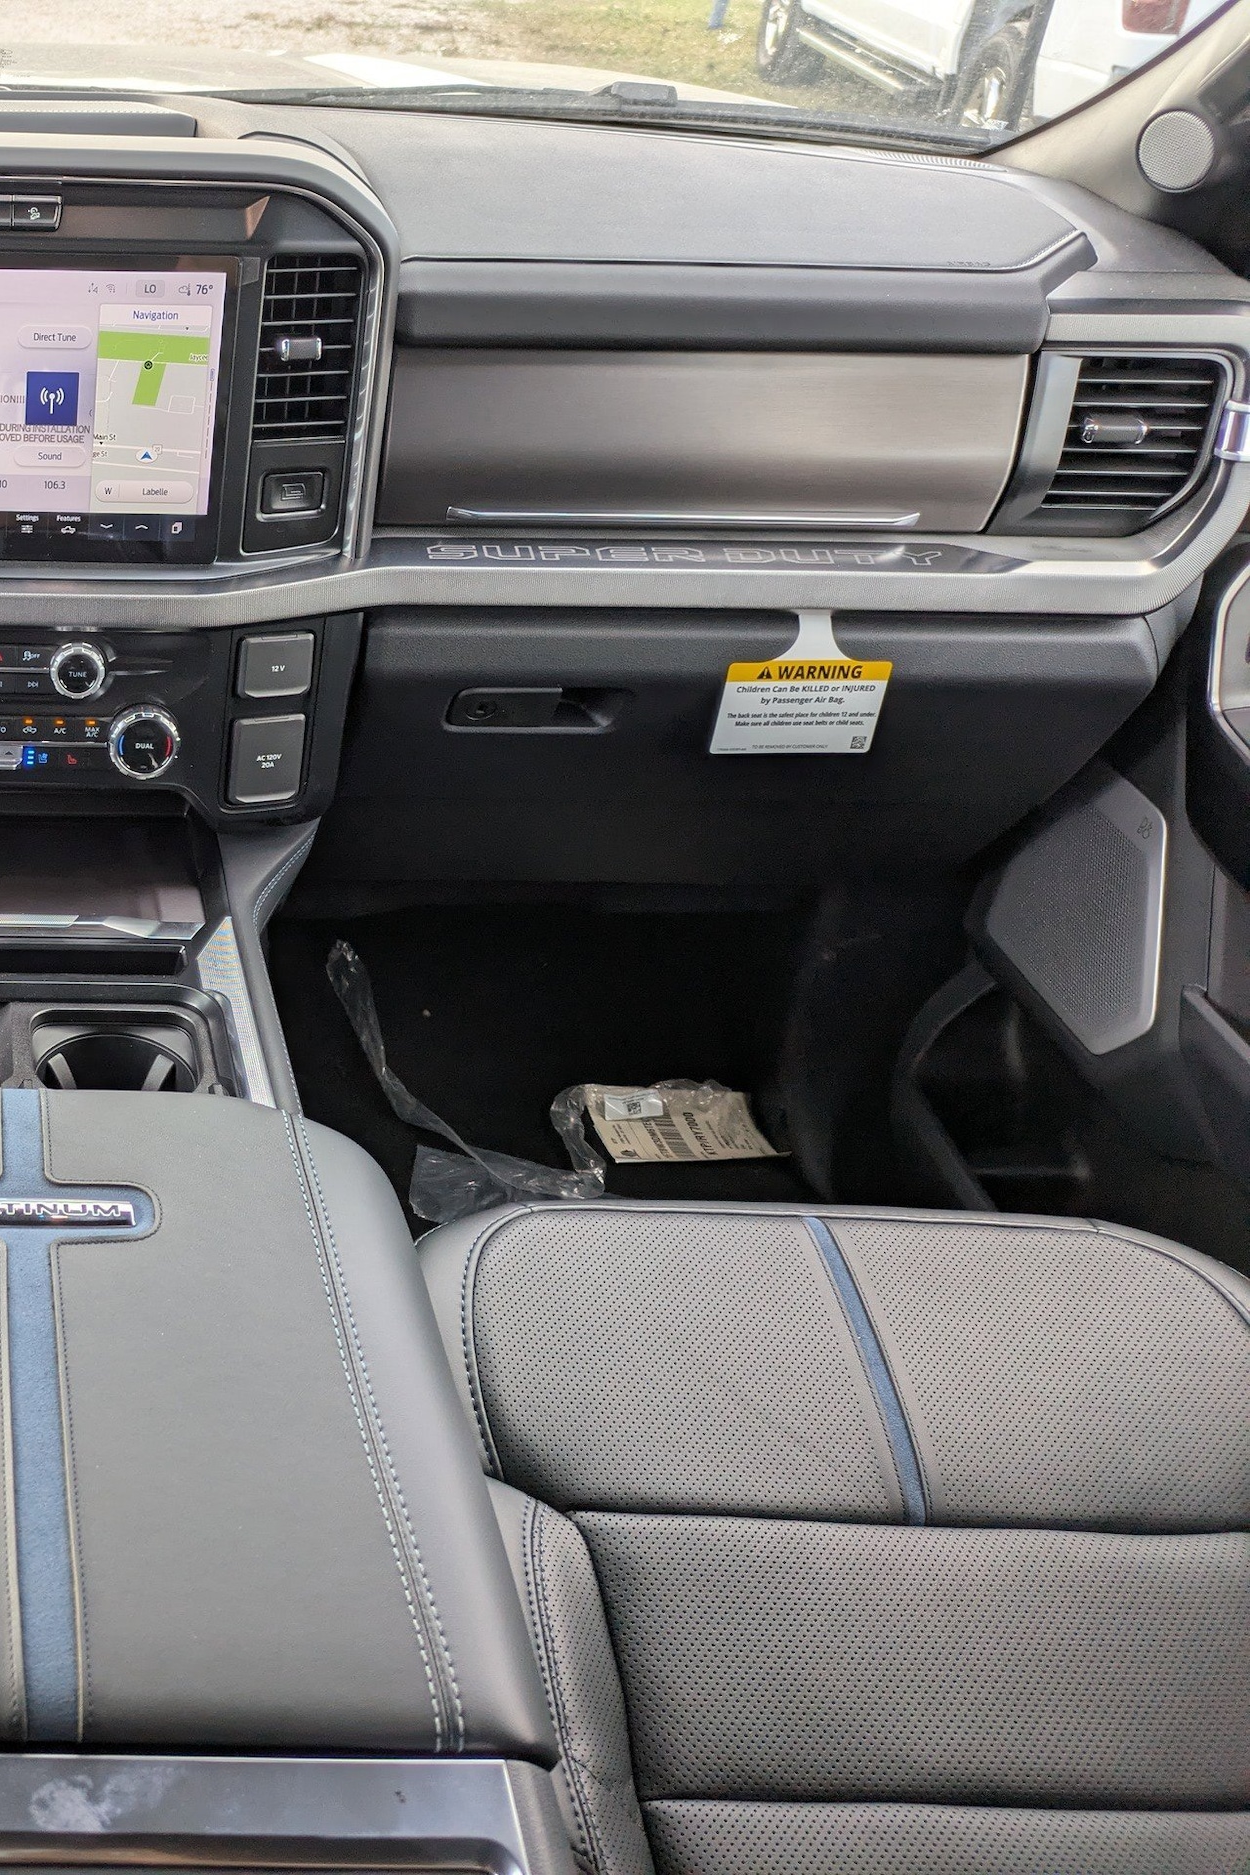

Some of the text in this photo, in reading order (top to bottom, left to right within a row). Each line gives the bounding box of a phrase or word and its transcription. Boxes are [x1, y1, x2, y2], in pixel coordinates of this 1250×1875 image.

[144, 284, 156, 294] LO
[196, 284, 214, 295] 76°
[133, 310, 178, 321] Navigation
[33, 332, 76, 342] Direct Tune
[0, 424, 30, 432] DURING
[32, 425, 90, 434] INSTALLATION
[23, 434, 56, 442] BEFORE
[57, 435, 84, 443] USAGE
[38, 452, 62, 460] Sound
[44, 481, 66, 489] 106.3
[426, 544, 943, 566] SUPER DUTY
[778, 665, 863, 680] WARNING
[772, 697, 813, 705] Passenger
[828, 696, 845, 704] Bag.
